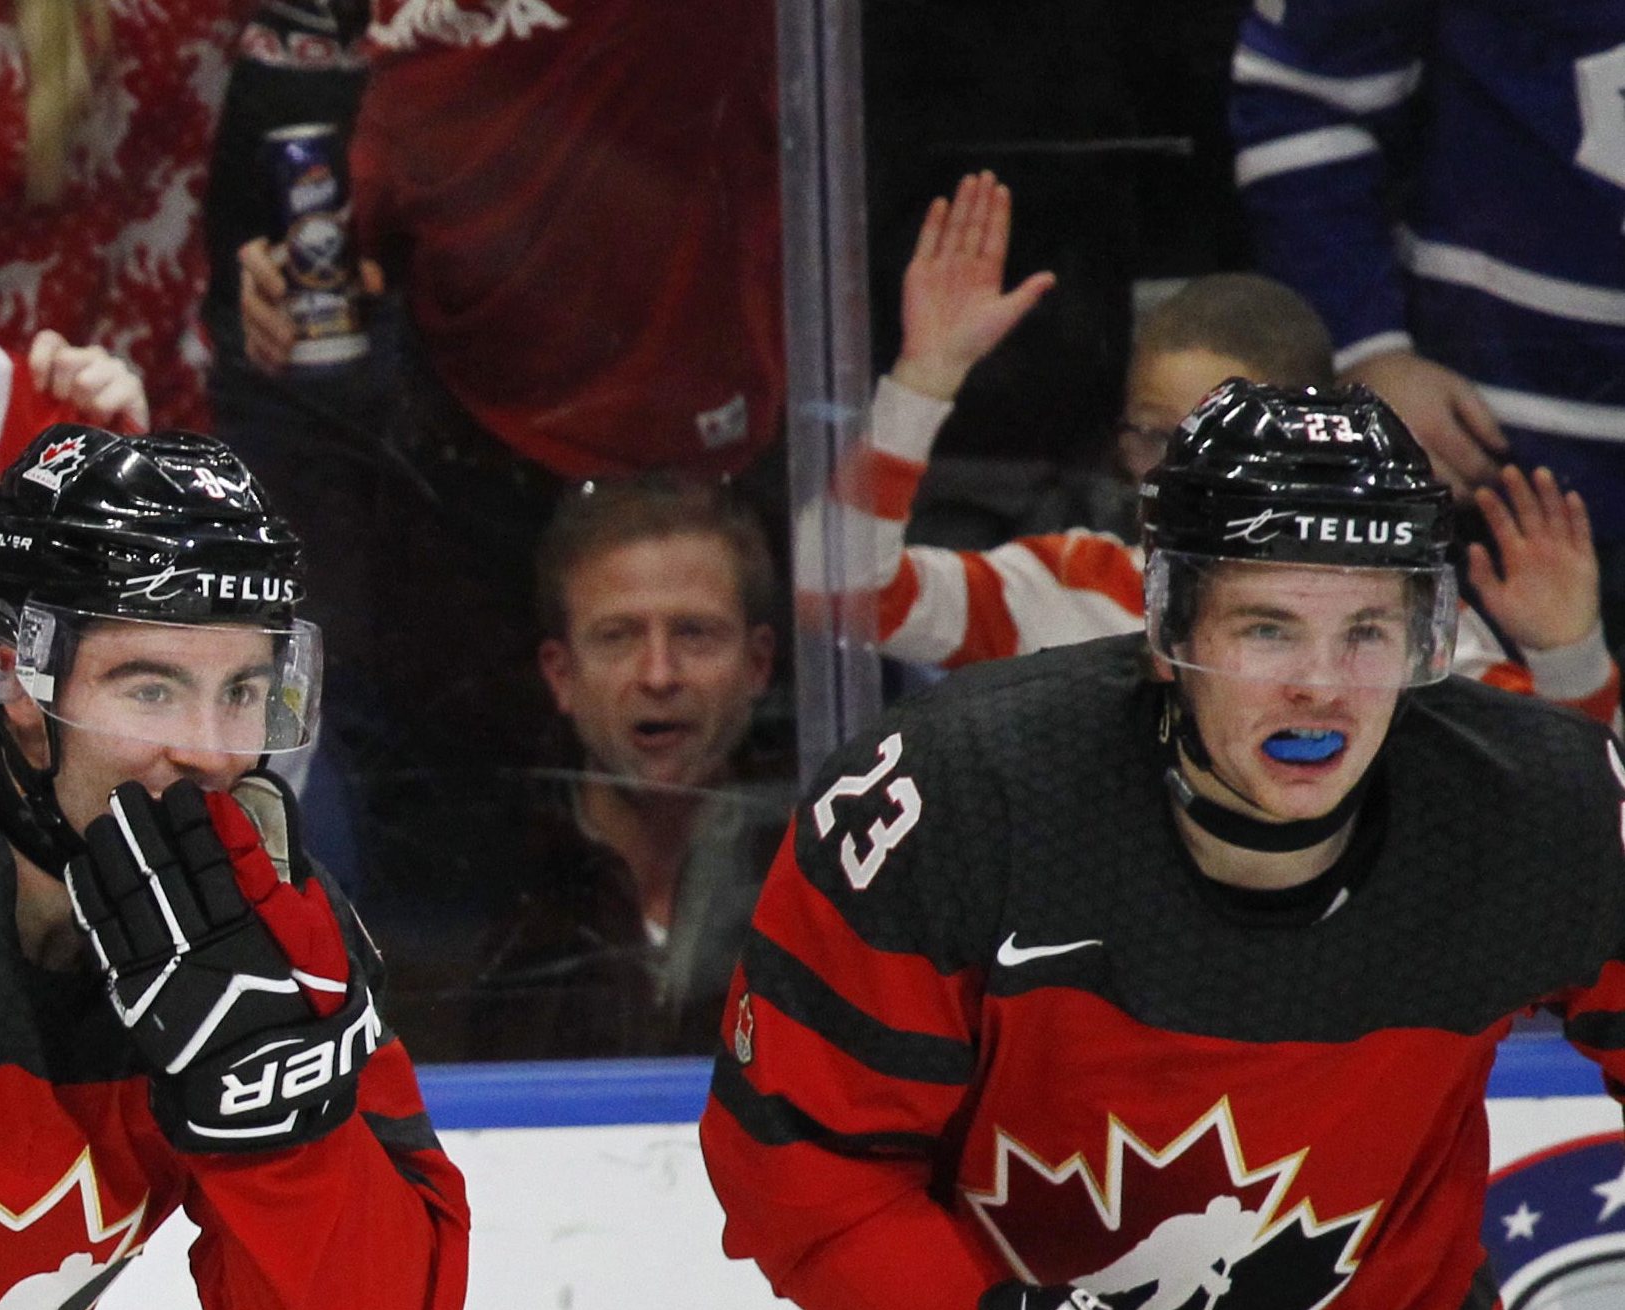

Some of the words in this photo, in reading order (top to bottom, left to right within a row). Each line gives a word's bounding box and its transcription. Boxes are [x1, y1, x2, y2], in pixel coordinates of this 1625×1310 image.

[1304, 413, 1354, 441] 23
[1294, 516, 1413, 546] TELUS
[196, 573, 294, 602] TELUS
[813, 732, 922, 890] 23
